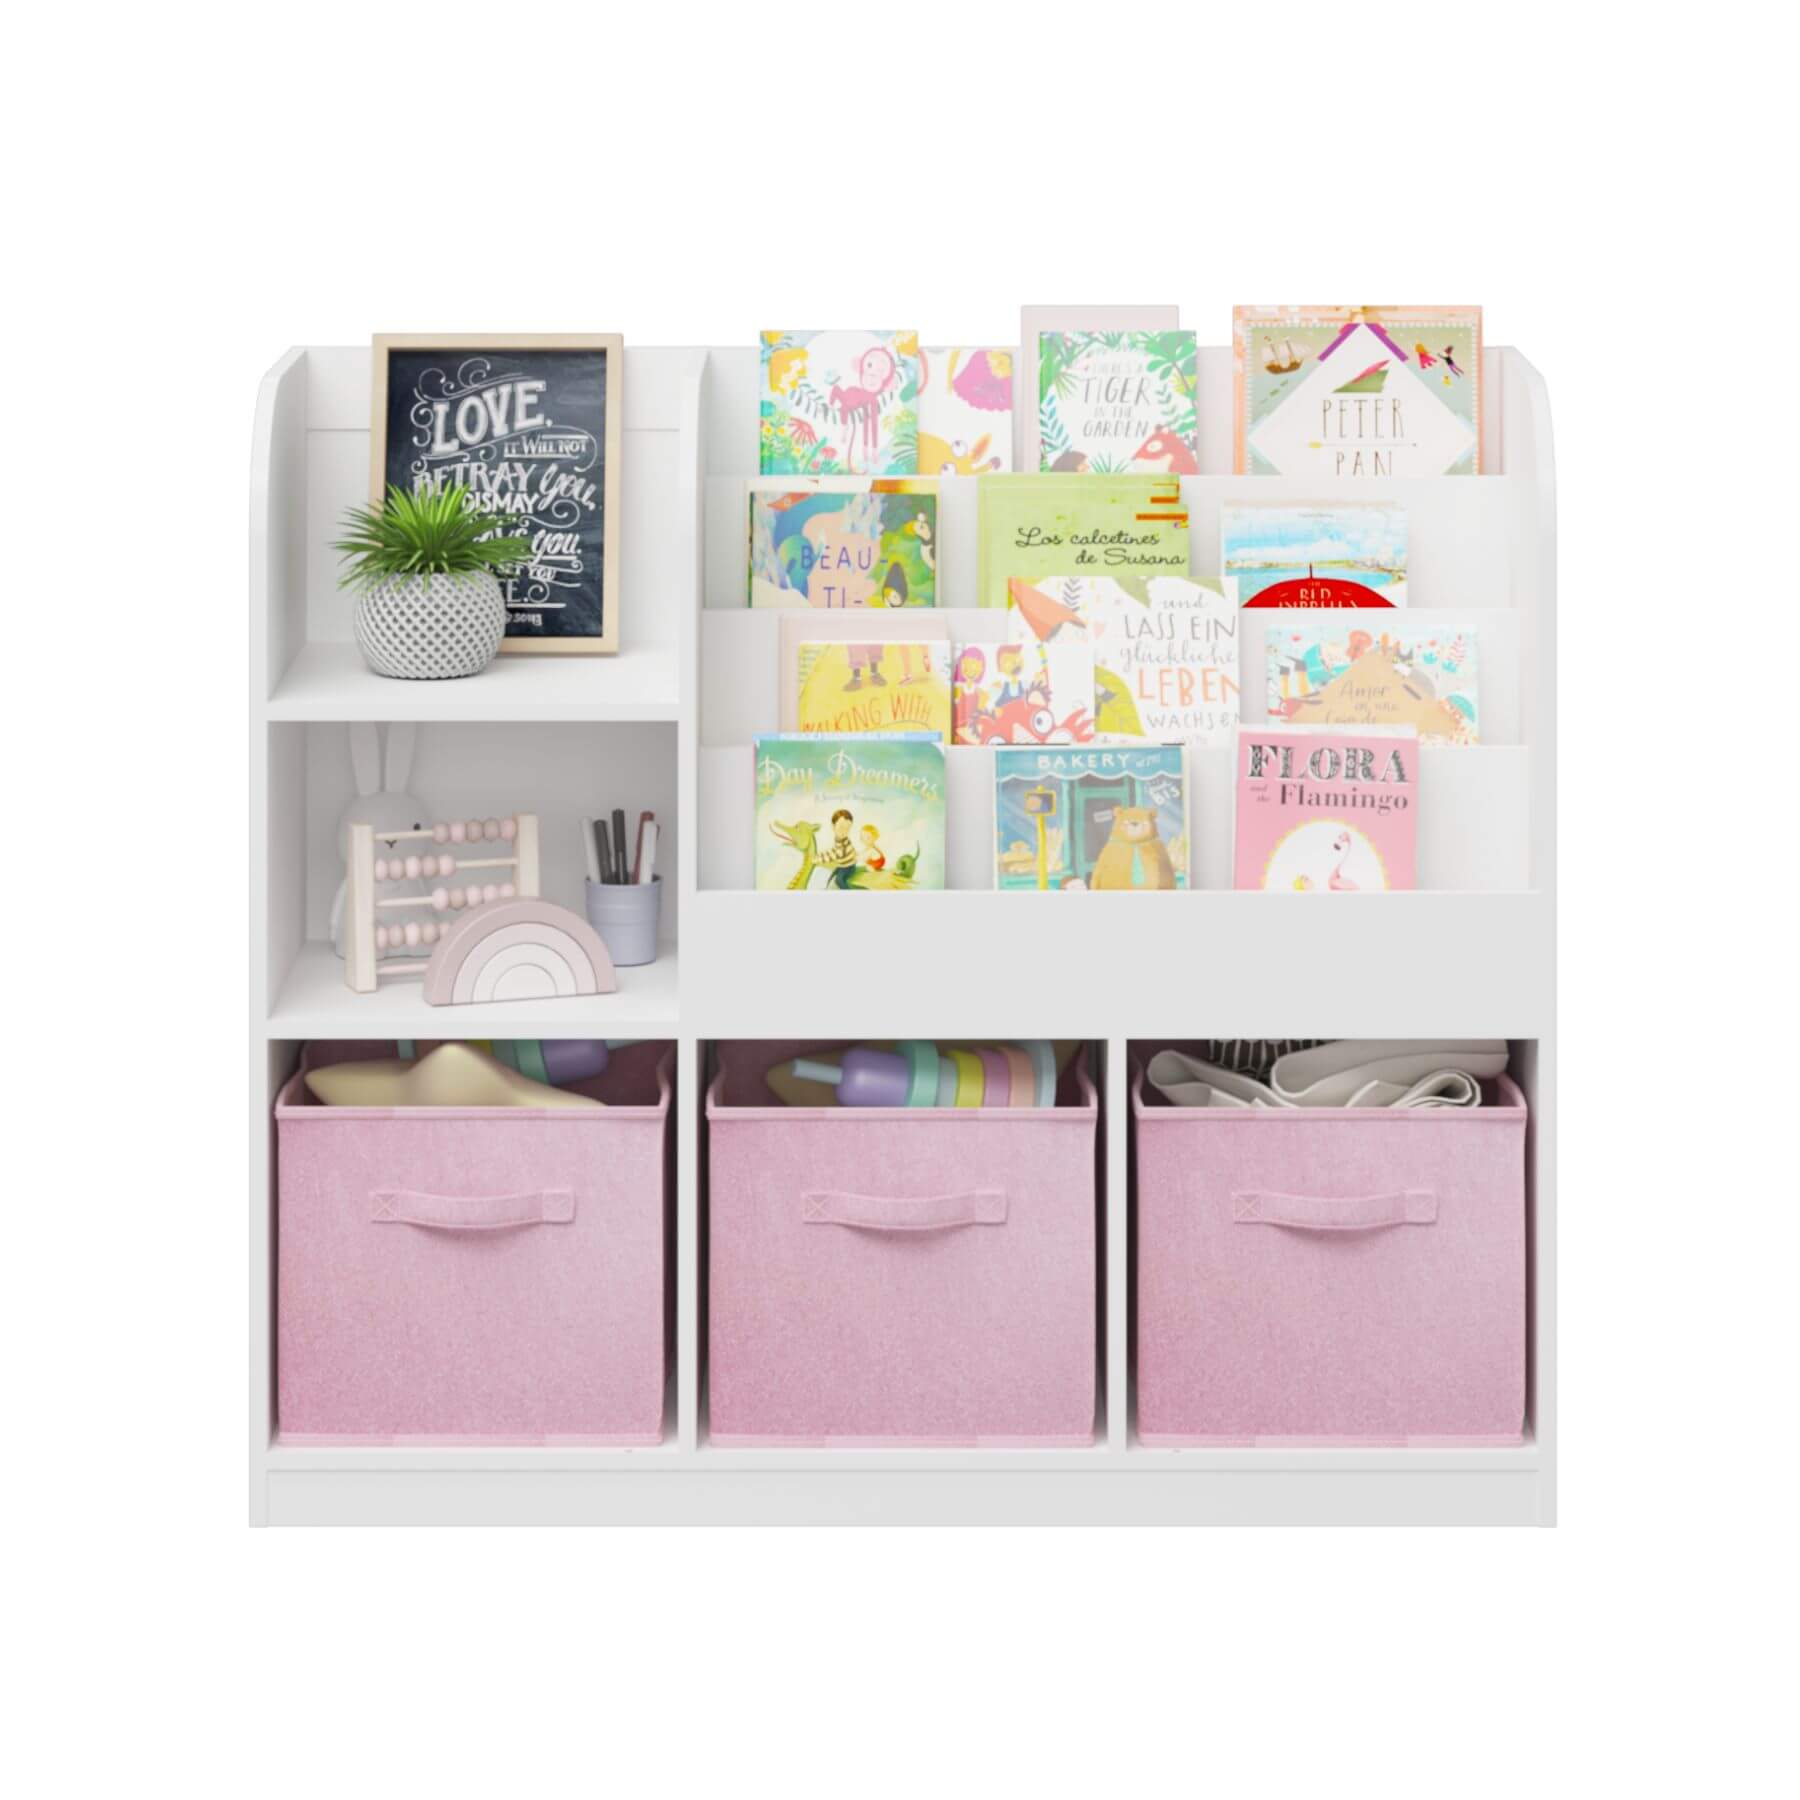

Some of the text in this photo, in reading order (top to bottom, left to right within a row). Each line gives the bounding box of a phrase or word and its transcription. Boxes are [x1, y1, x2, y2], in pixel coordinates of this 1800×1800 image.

[1080, 375, 1152, 407] TIGER
[430, 380, 553, 456] LOVE.
[1082, 419, 1150, 438] GARDEN
[1321, 398, 1404, 438] PETER
[1335, 451, 1393, 476] PAN
[1014, 526, 1161, 548] Los calcetines
[799, 546, 889, 570] BEAU-
[1075, 547, 1186, 566] de Susana
[1157, 592, 1208, 609] und
[1123, 611, 1236, 643] LASS EIN
[1138, 666, 1240, 708] LEBEN
[889, 691, 933, 722] WITH
[757, 750, 940, 802] Day Dreamers
[1037, 753, 1131, 769] BAKERY
[1247, 744, 1412, 784] FLORA
[1280, 782, 1409, 816] Flamingo
